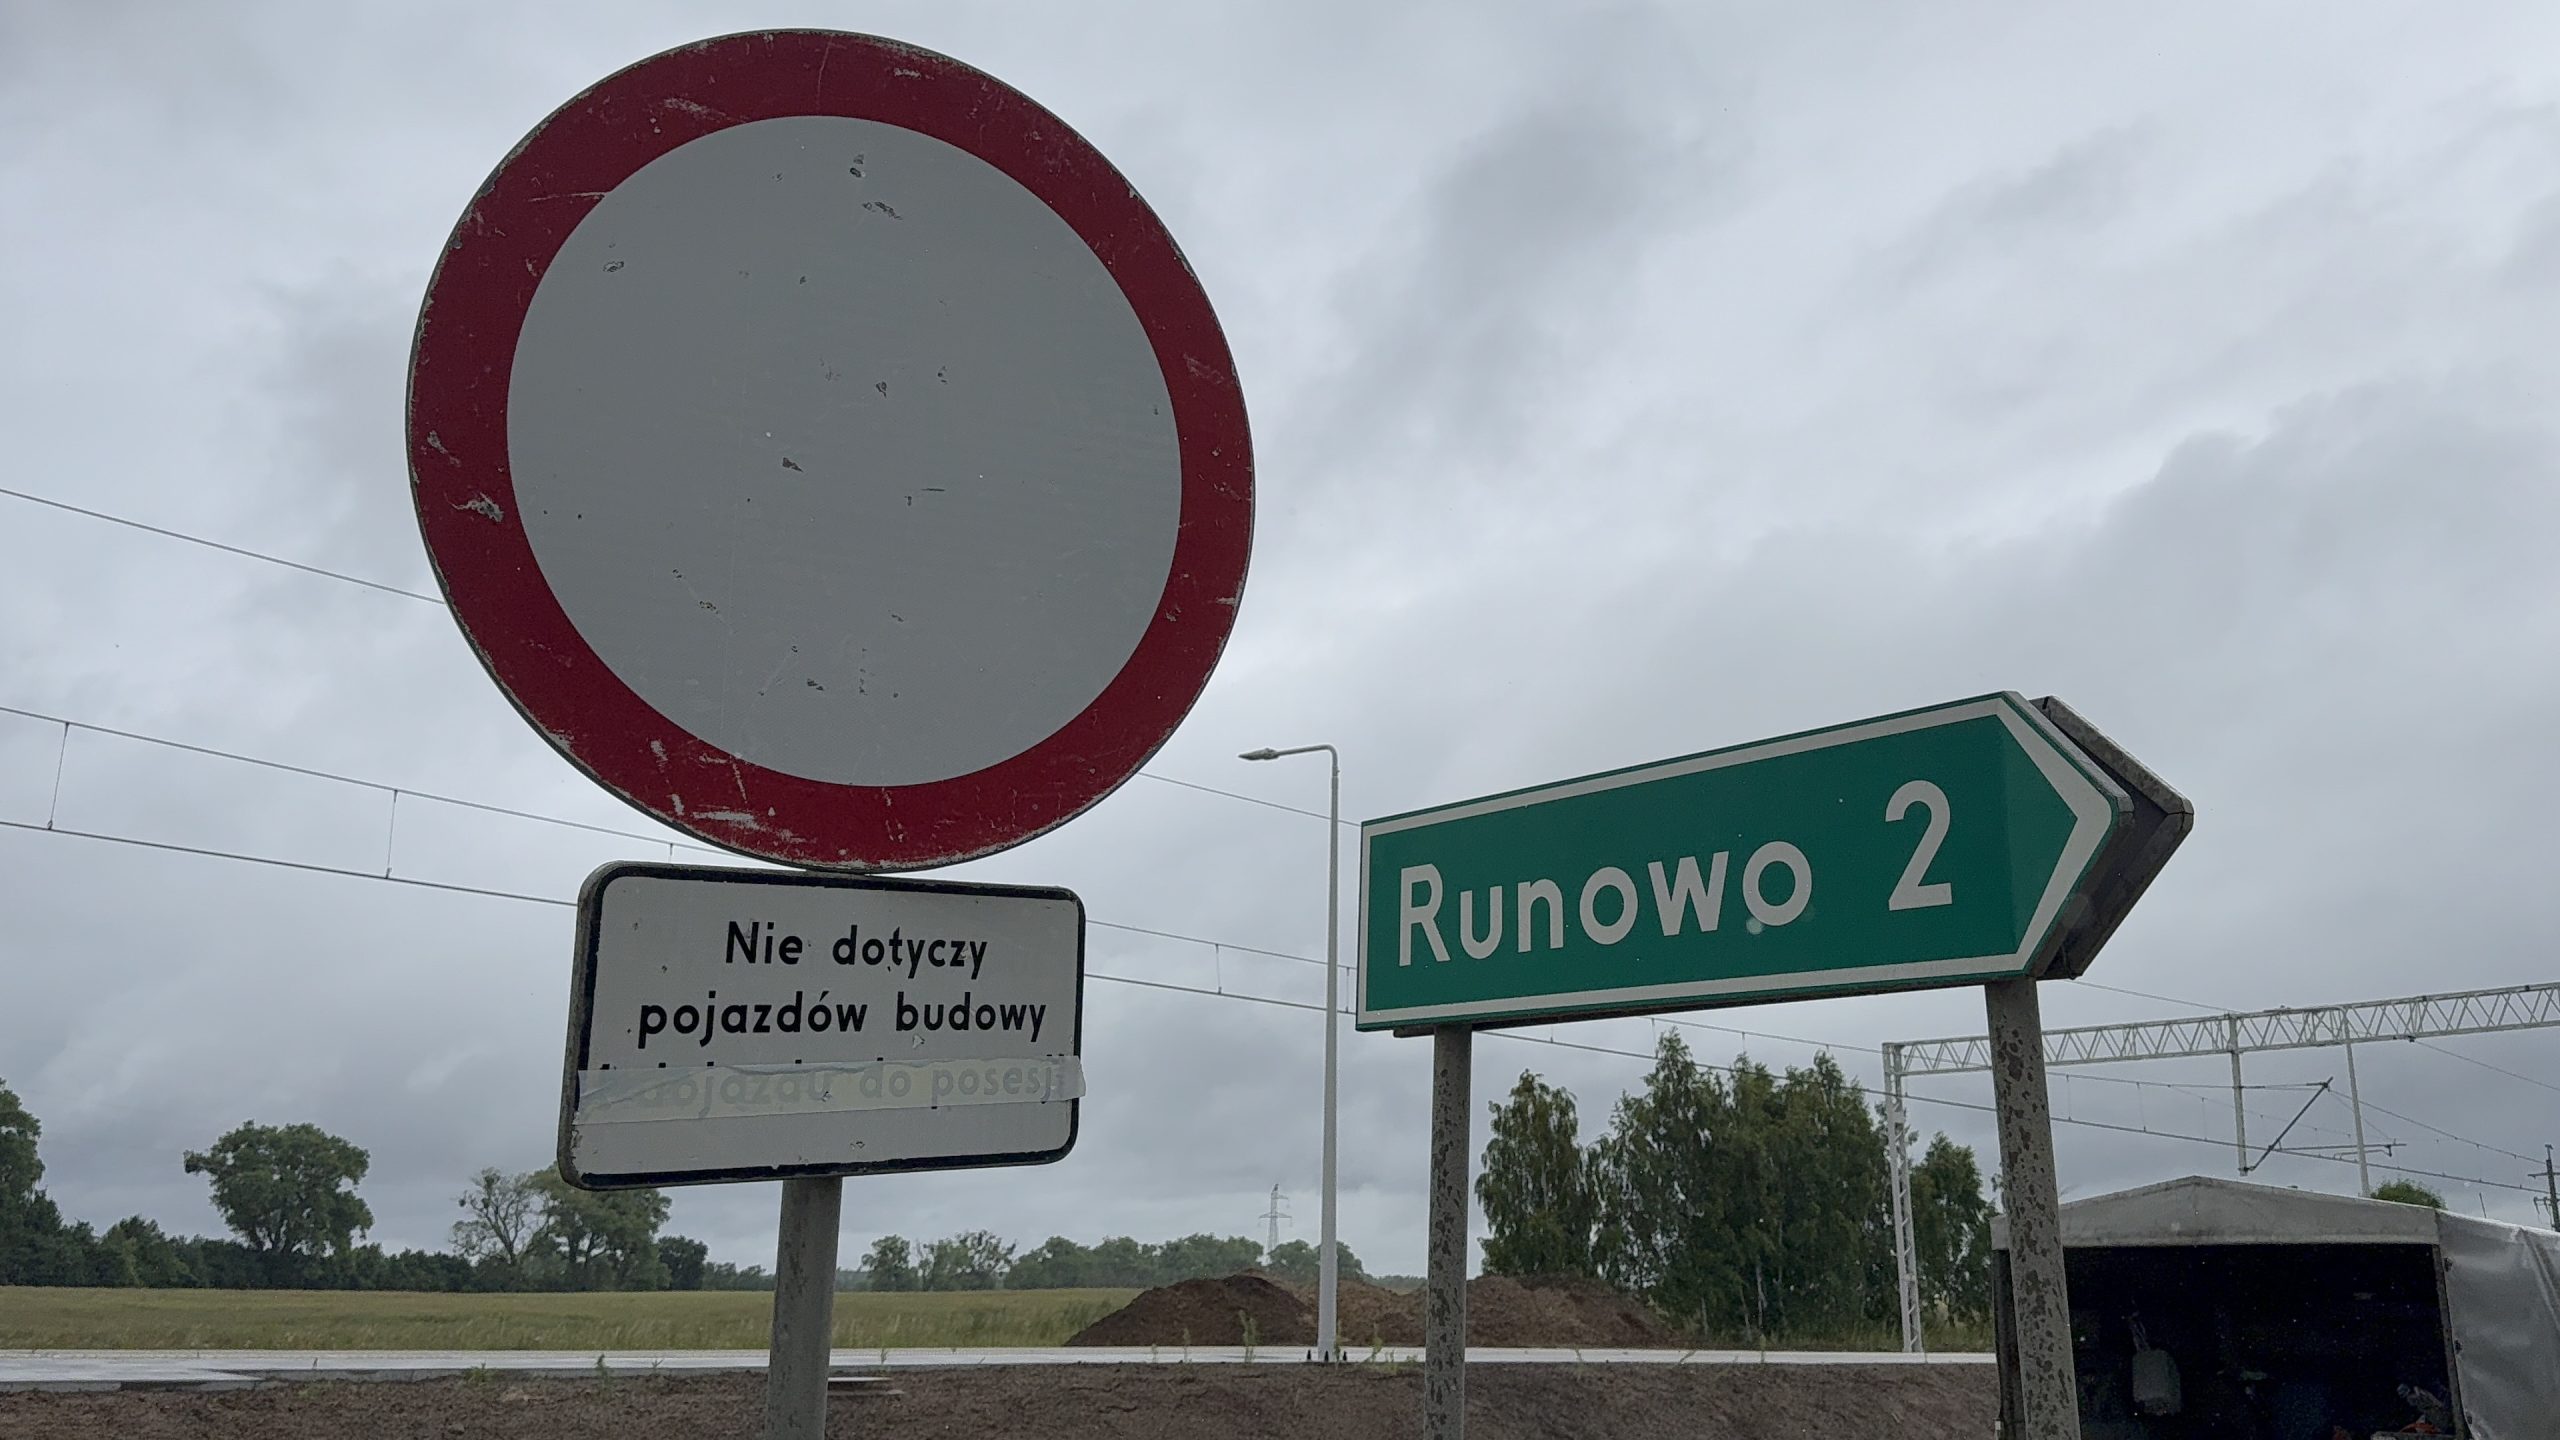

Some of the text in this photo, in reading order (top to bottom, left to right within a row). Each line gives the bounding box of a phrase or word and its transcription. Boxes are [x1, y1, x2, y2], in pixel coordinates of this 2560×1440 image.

[1399, 780, 1953, 967] Runowo 2
[725, 920, 988, 980] Nie dotyczy
[637, 990, 1047, 1049] pojazdów budowy
[860, 1057, 911, 1098] do
